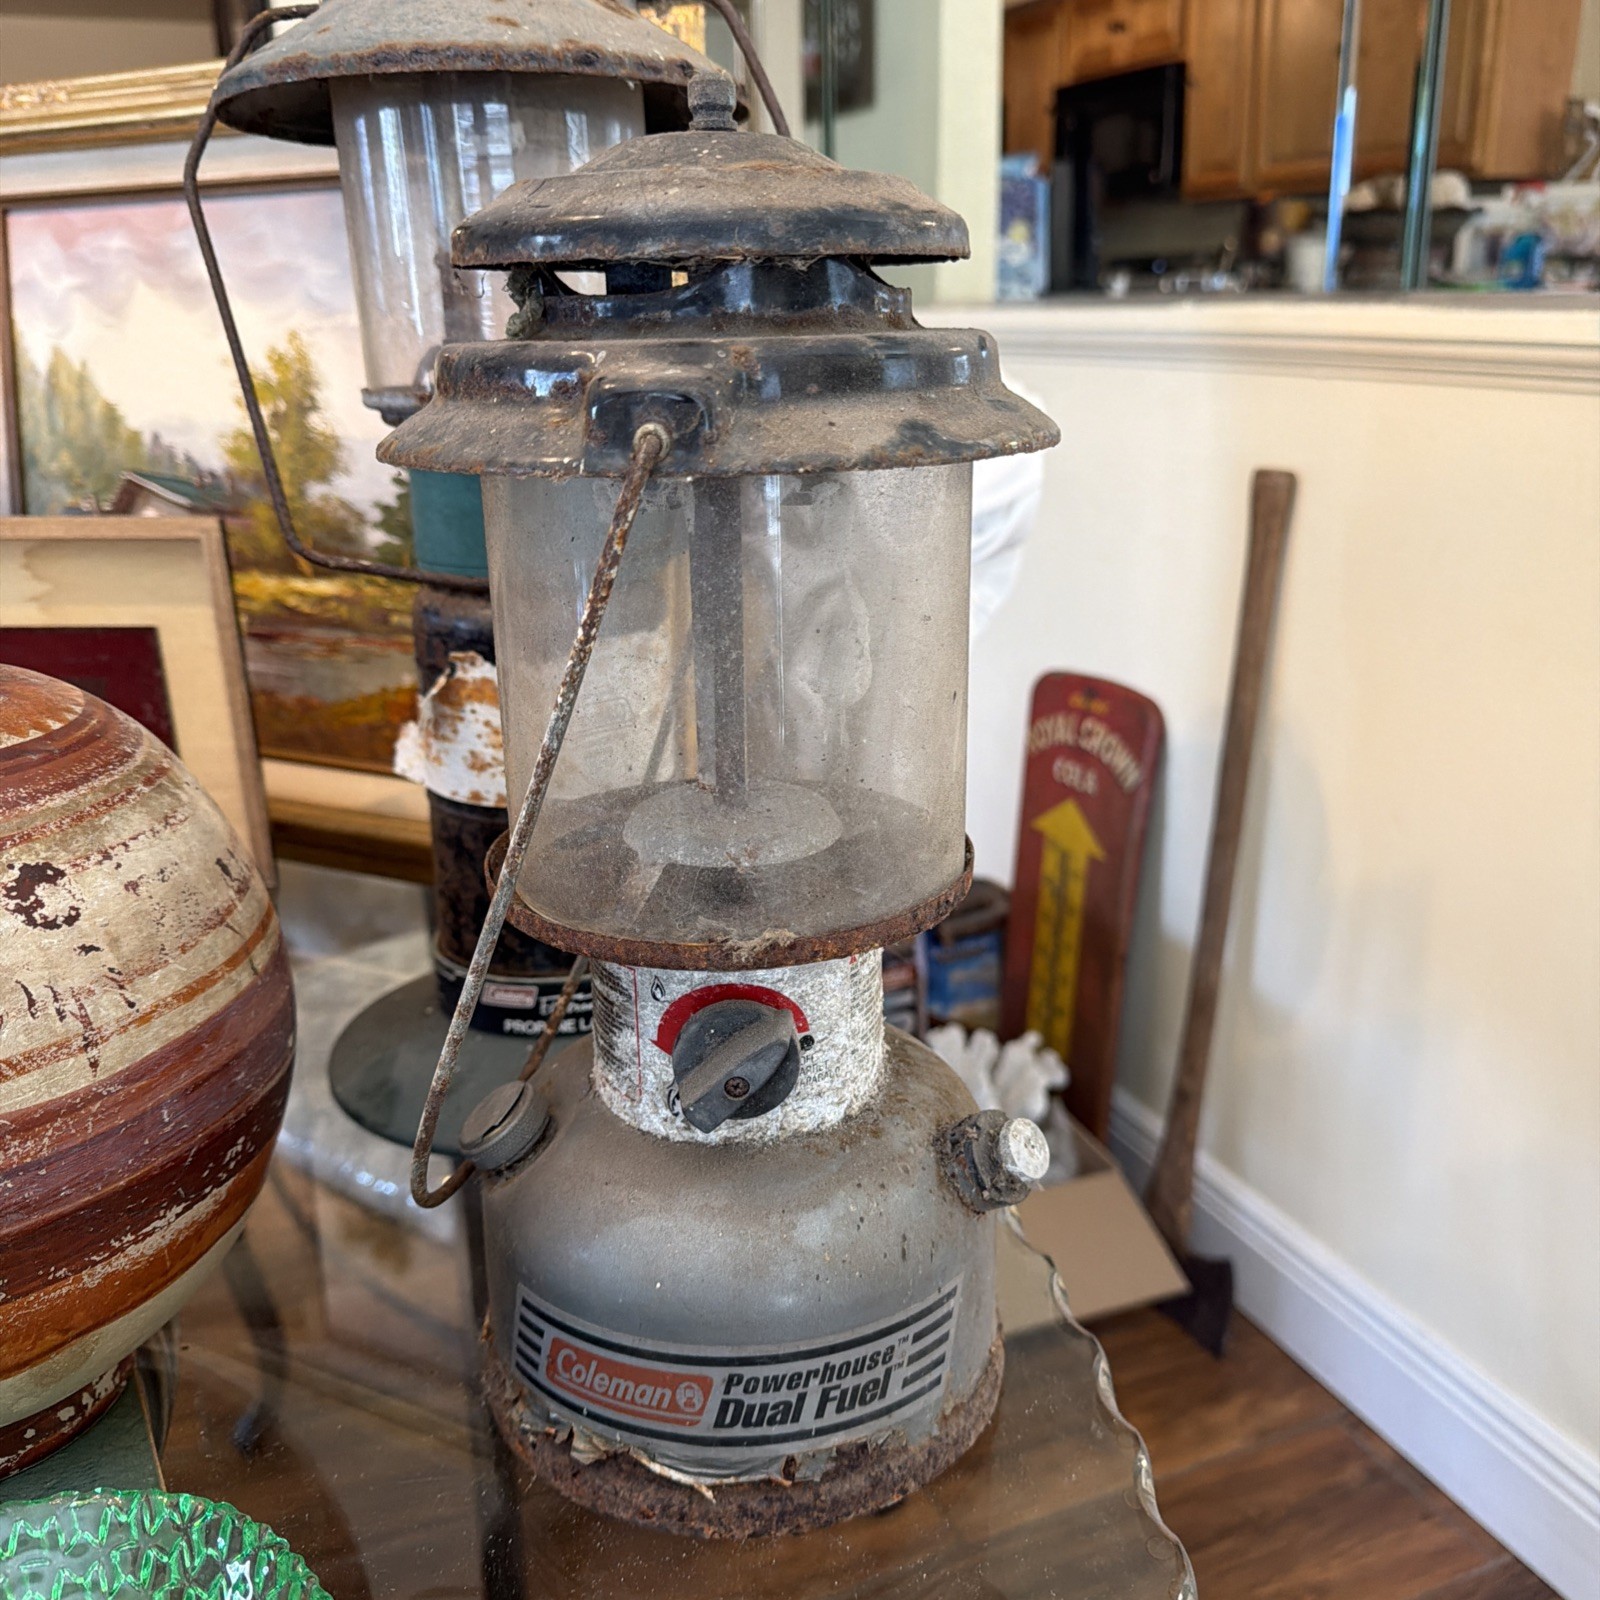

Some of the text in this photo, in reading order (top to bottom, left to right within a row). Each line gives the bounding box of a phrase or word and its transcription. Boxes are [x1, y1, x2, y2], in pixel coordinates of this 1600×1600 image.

[502, 1017, 577, 1034] PROPNE
[556, 1347, 673, 1410] Coleman
[713, 1392, 808, 1429] Dual
